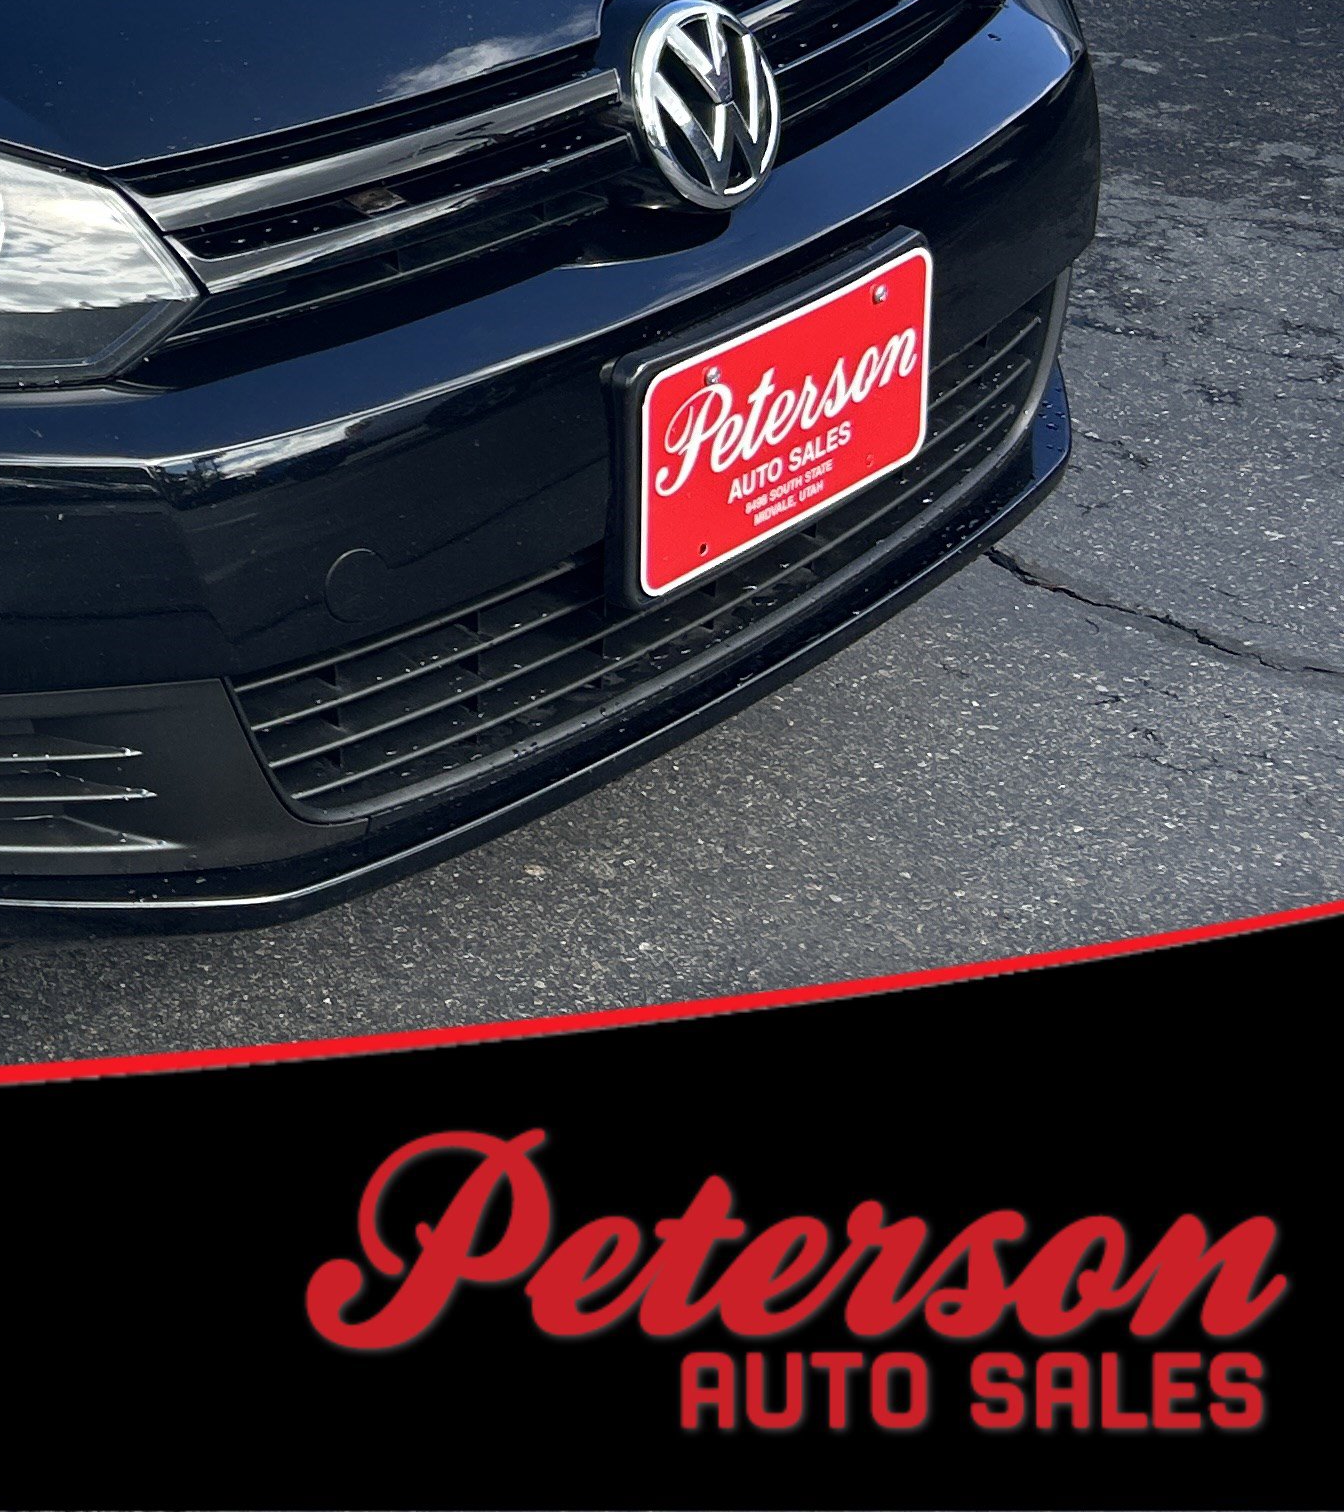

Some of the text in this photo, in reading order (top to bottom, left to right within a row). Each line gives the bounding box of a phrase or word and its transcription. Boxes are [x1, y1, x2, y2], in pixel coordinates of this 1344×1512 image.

[655, 327, 918, 497] Peterson
[727, 421, 852, 505] AUTO SALES
[769, 475, 803, 502] SOUTH
[804, 458, 834, 483] STATE
[798, 479, 824, 502] UTAH
